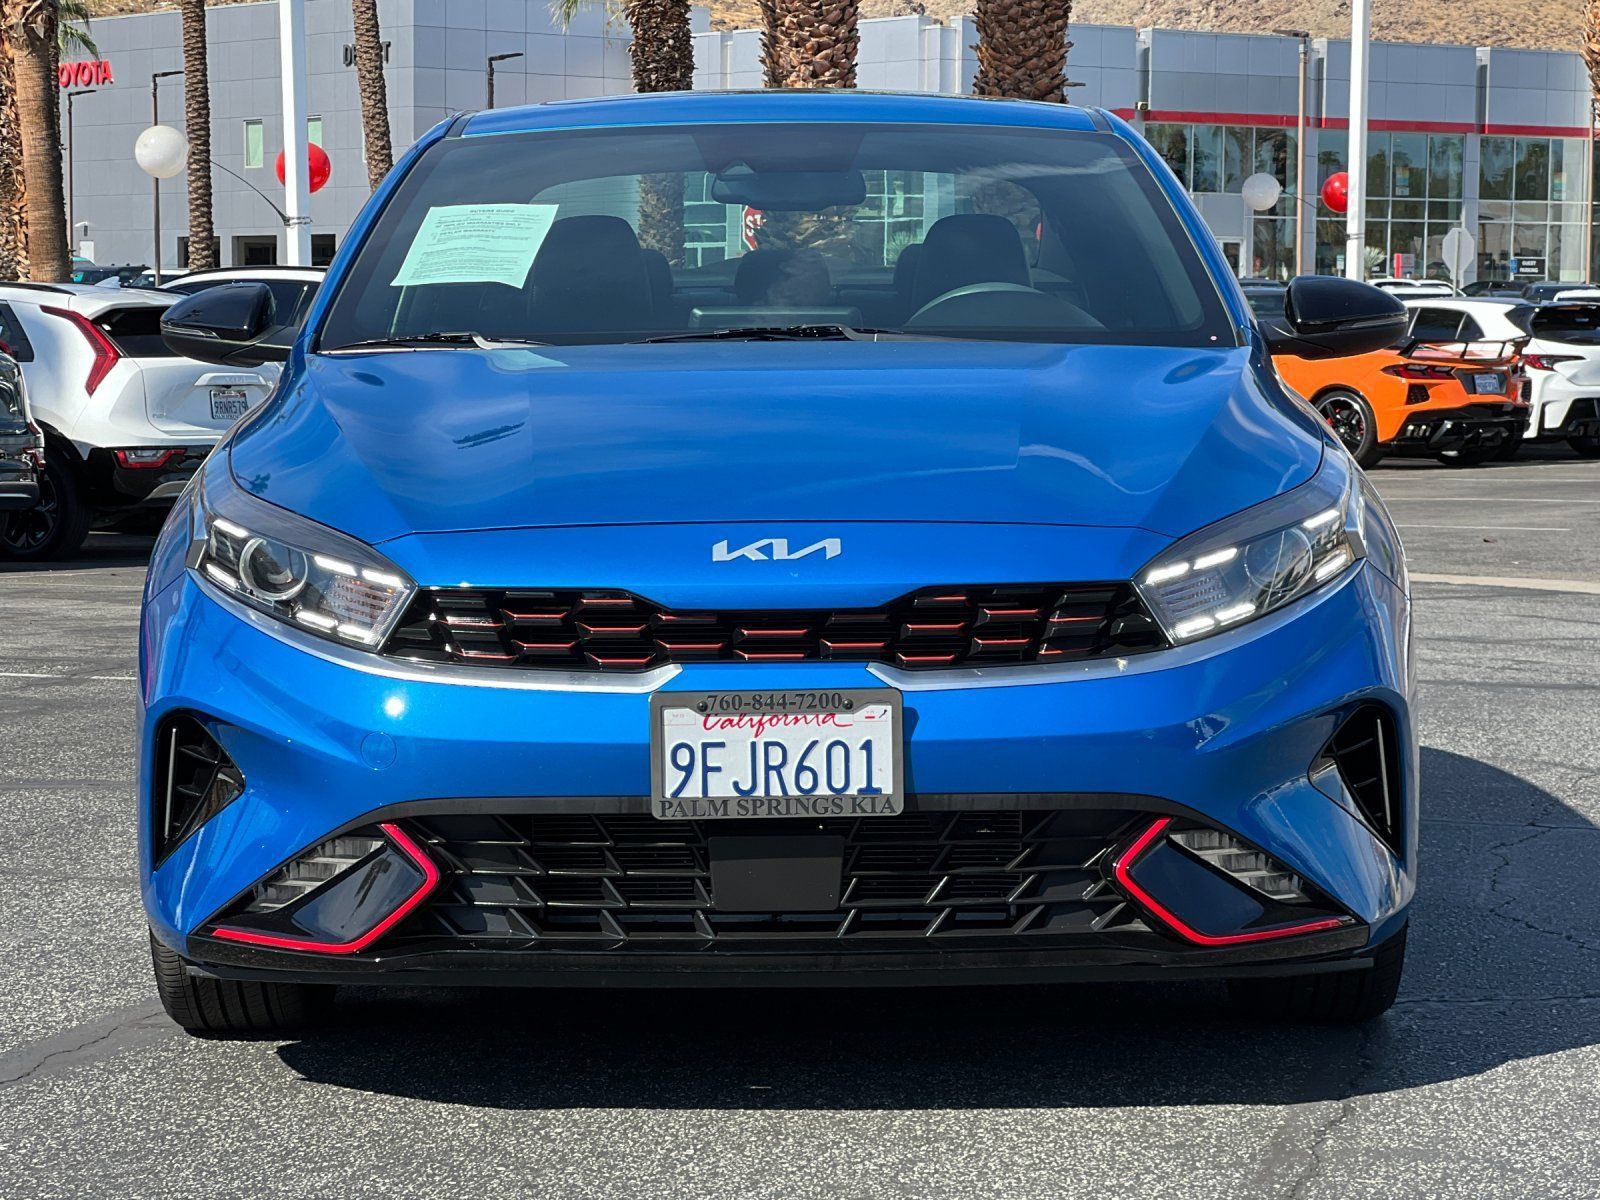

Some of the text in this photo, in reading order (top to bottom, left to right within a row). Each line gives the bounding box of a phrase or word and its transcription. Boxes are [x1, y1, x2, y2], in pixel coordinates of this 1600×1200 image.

[57, 60, 114, 88] OYOTA
[712, 538, 842, 562] KIA
[706, 692, 843, 712] 760-844-7200
[702, 711, 853, 738] California
[670, 739, 883, 798] 9FJR601
[659, 796, 897, 818] PALM SPRINGS KIA
